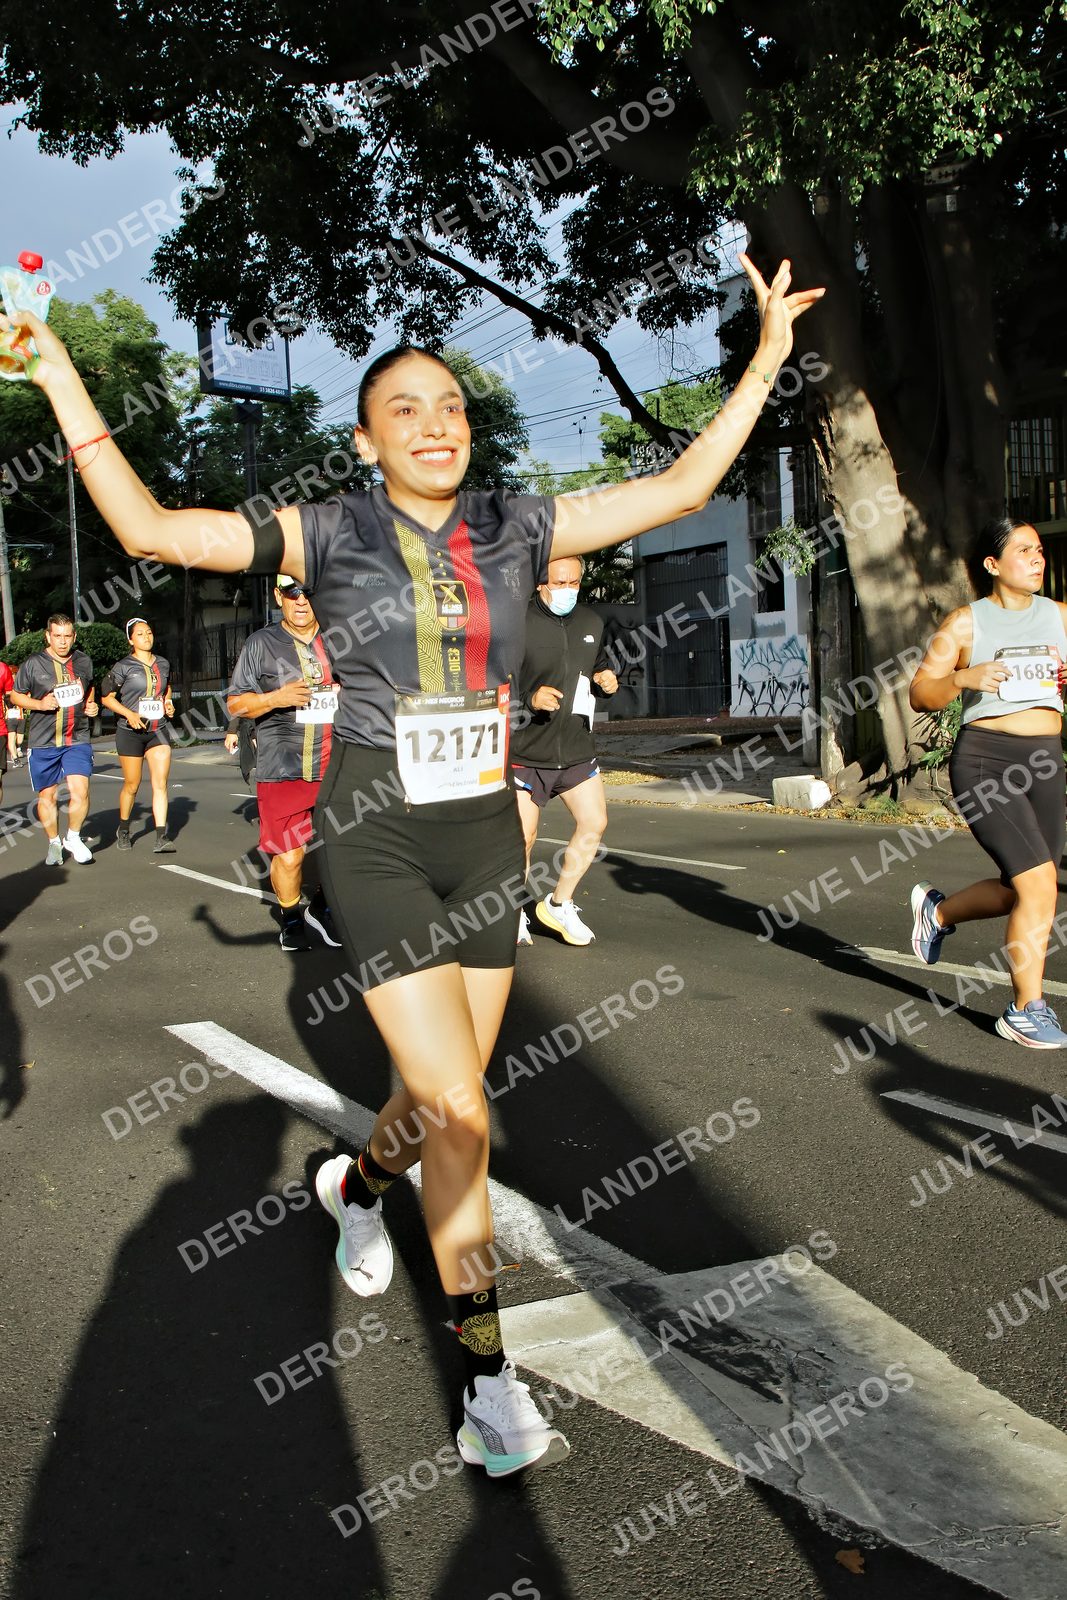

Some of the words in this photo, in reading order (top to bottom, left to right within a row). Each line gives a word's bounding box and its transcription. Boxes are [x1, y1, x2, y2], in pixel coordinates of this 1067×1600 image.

[56, 688, 81, 699] 12328
[309, 697, 336, 710] 264
[404, 721, 499, 764] 12171
